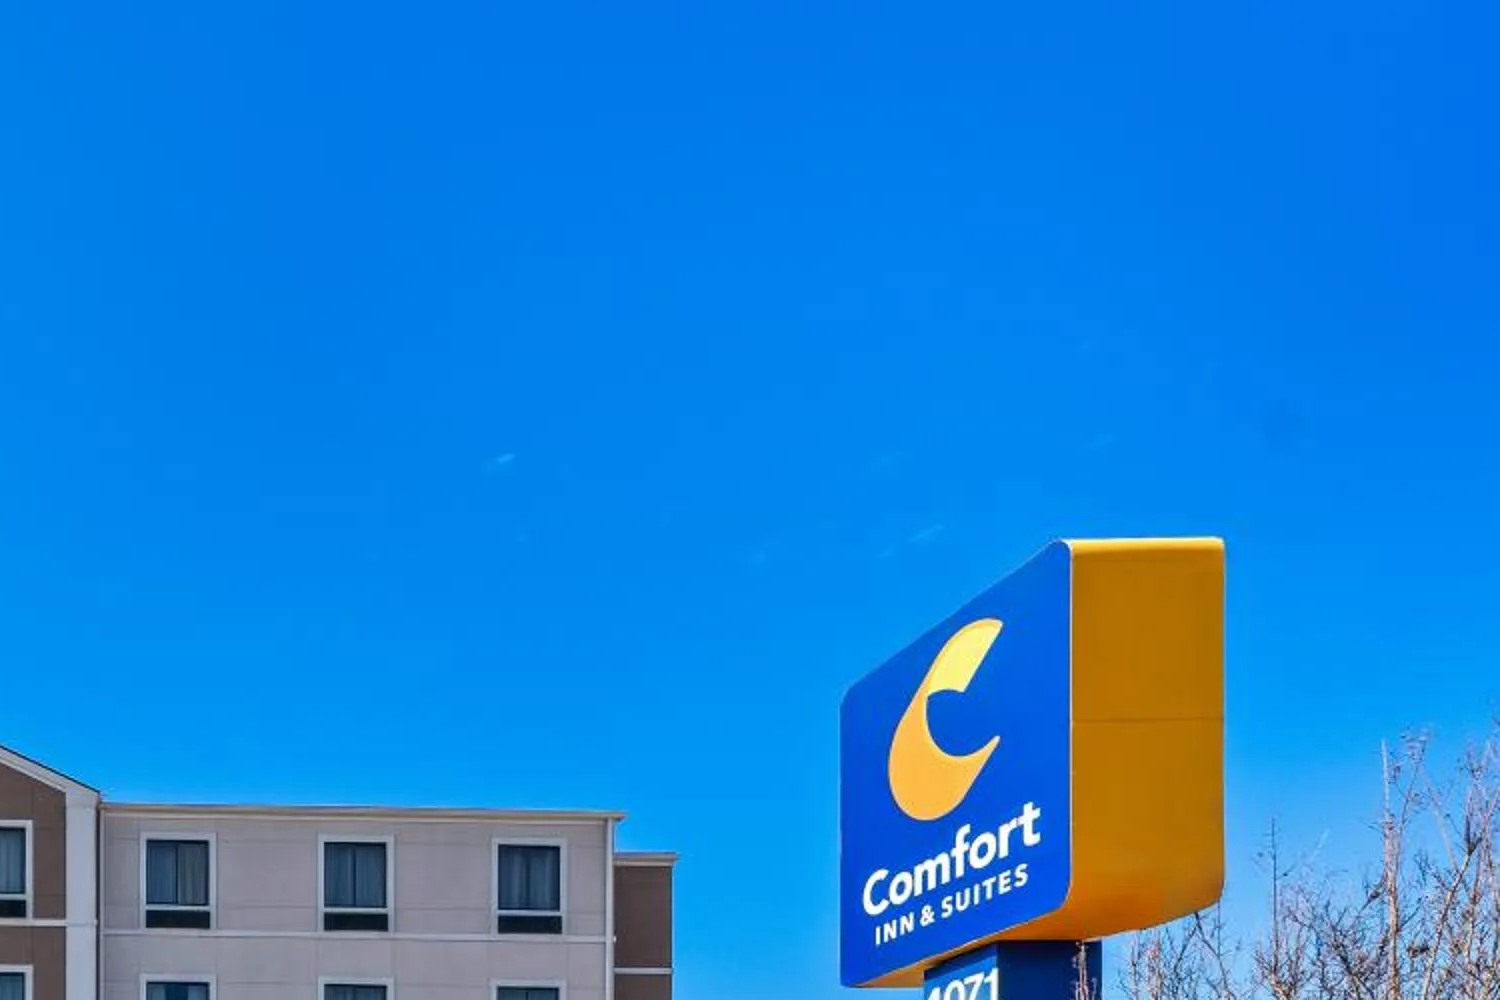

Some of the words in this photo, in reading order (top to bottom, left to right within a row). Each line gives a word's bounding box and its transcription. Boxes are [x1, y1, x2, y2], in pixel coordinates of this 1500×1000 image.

[862, 801, 1041, 916] Comfort
[875, 911, 915, 946] INN
[919, 904, 936, 926] &
[940, 863, 1029, 919] SUITES
